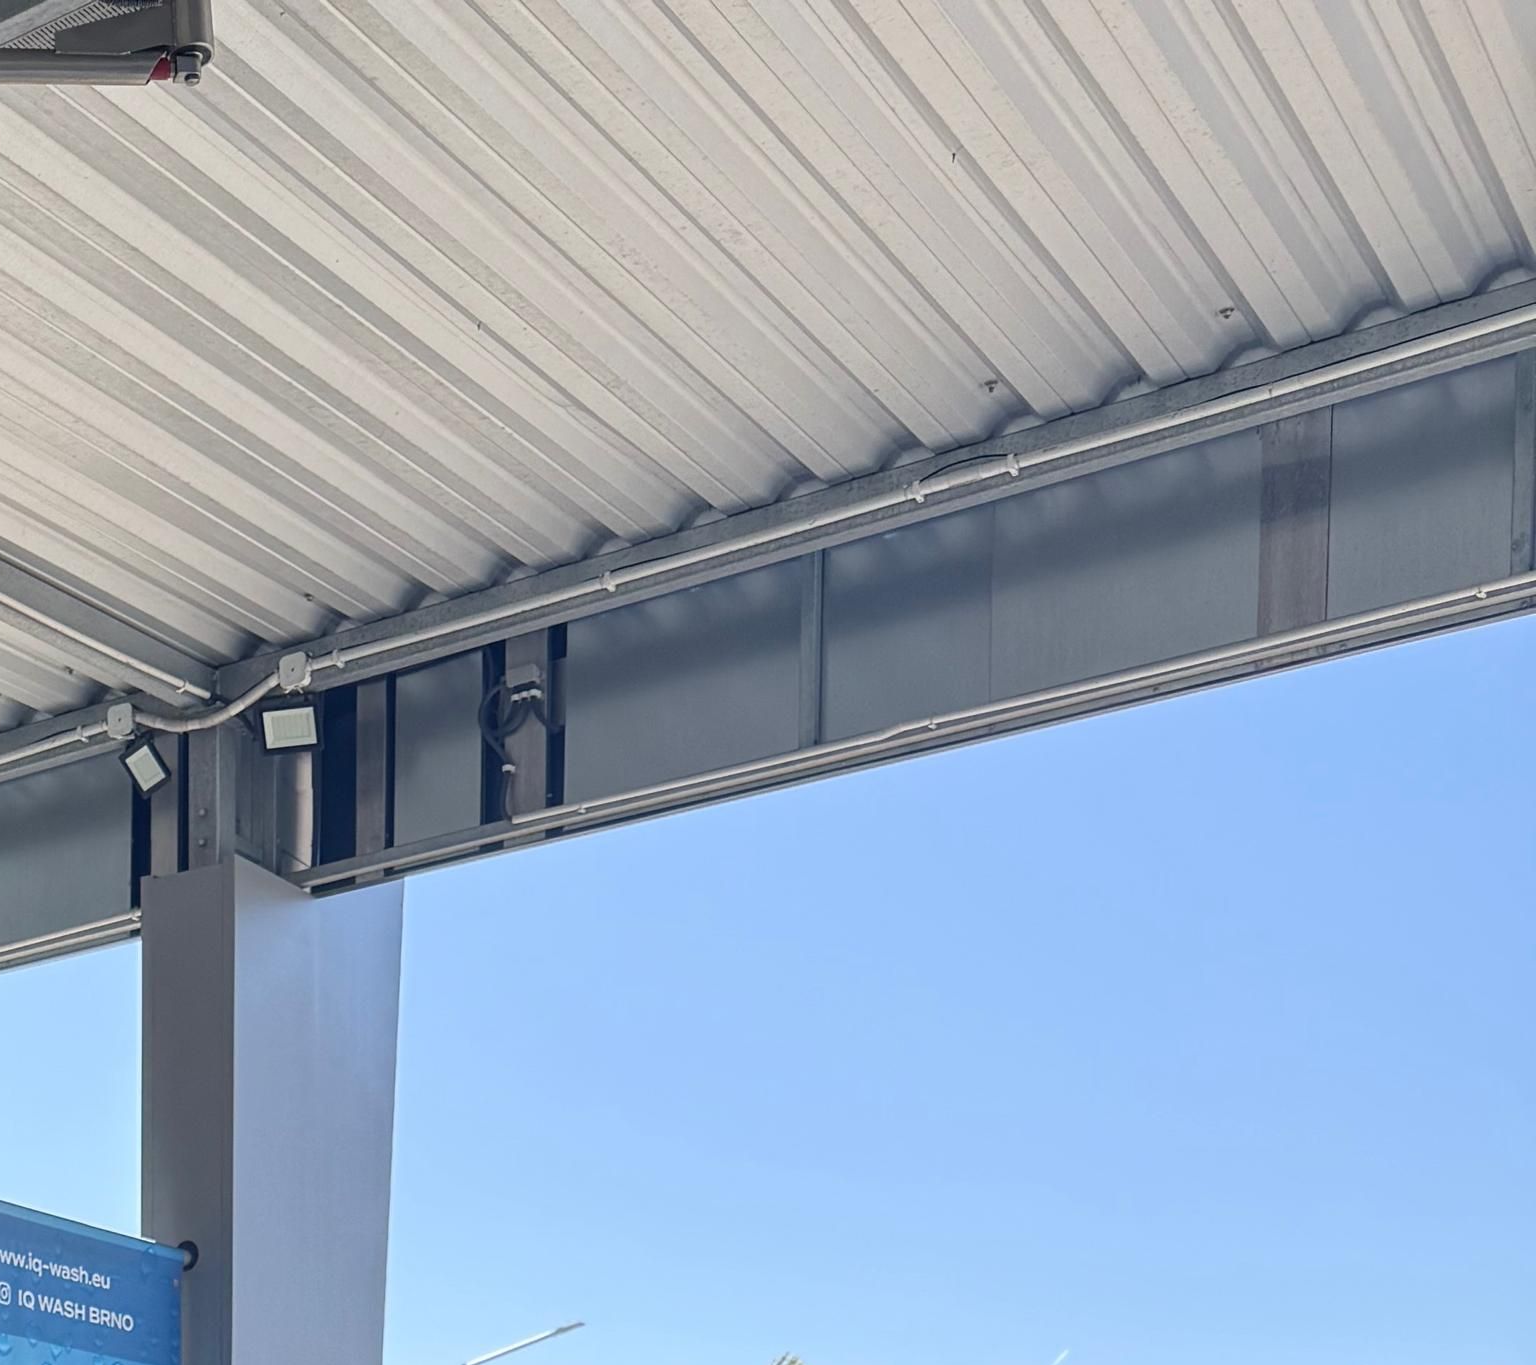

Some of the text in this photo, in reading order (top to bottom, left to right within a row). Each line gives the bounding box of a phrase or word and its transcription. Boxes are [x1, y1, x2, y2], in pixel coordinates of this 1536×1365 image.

[18, 1289, 35, 1311] IQ
[38, 1294, 85, 1321] WASH
[89, 1307, 134, 1332] BRNO
